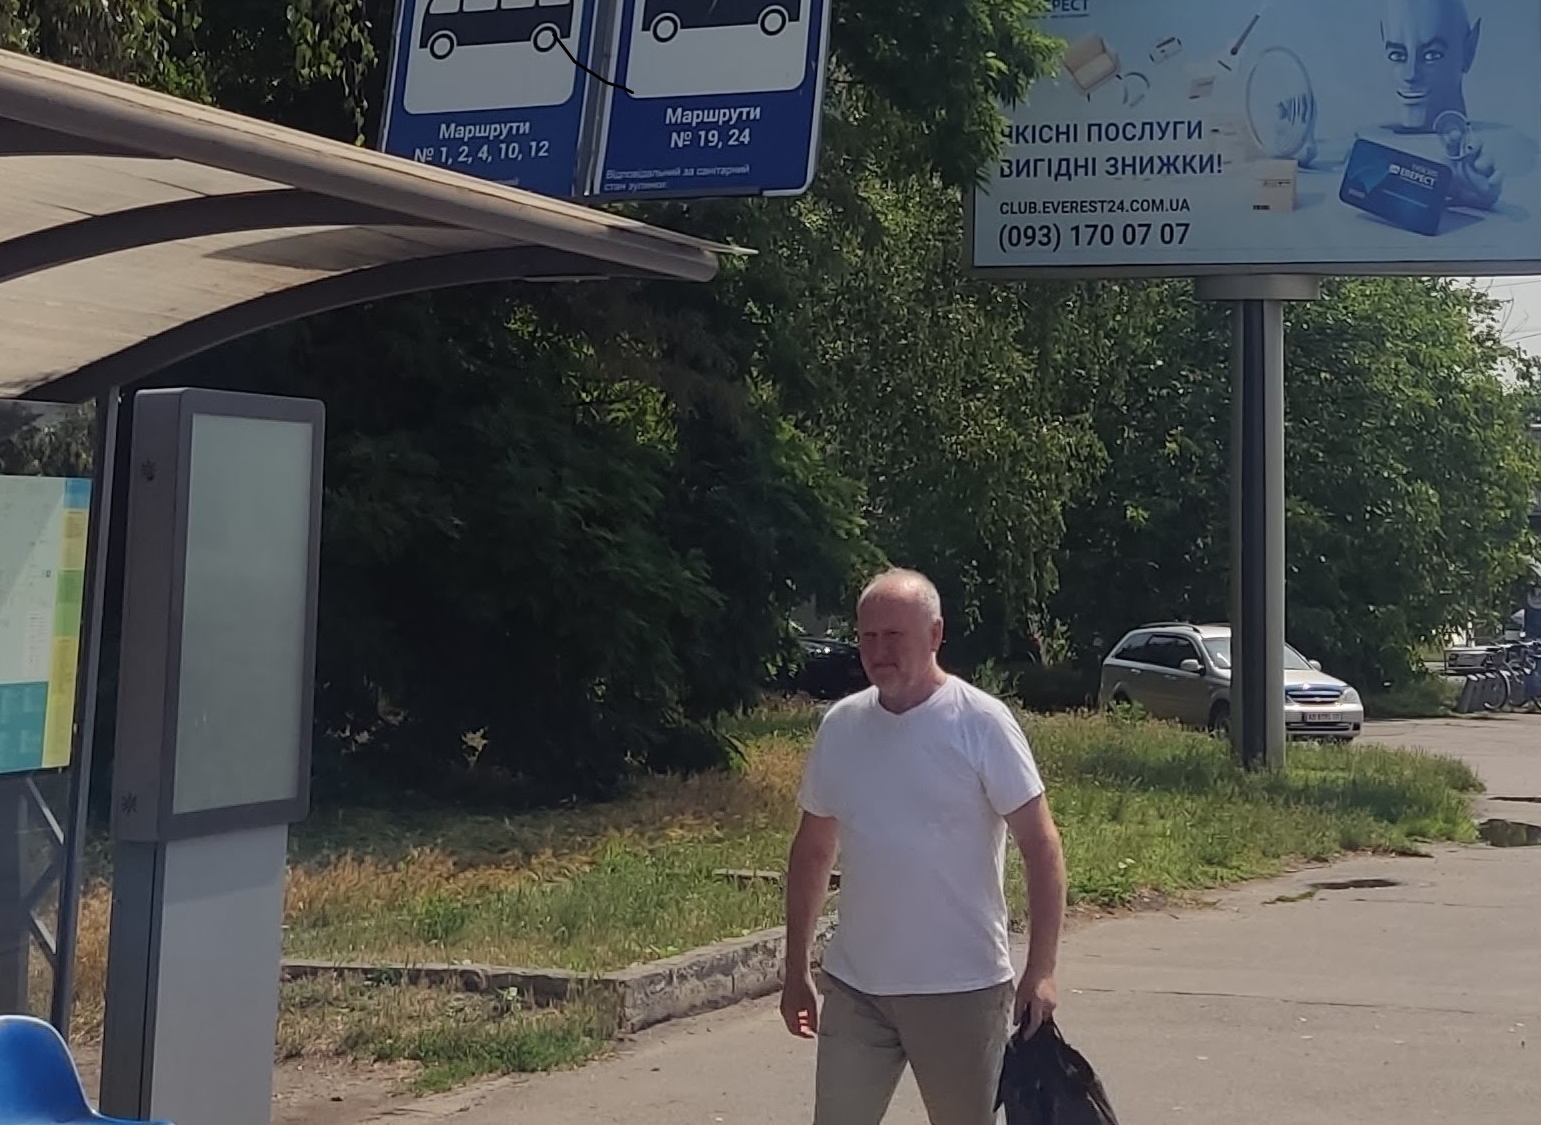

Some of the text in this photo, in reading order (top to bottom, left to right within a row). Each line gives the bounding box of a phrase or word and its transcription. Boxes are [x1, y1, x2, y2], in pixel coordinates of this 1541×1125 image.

[665, 106, 761, 127] Маршрути
[439, 121, 531, 142] Маршрути
[670, 128, 750, 149] № 19, 24
[1000, 124, 1078, 144] ЯКІСНІ
[1087, 120, 1203, 143] ПОСЛУГИ
[414, 141, 549, 165] № 1, 2, 4, 10, 12
[1000, 153, 1223, 181] ВИГІДНІ ЗНИЖКИ!
[1000, 198, 1191, 215] CLUB.EVEREST24.COM.UA
[999, 223, 1191, 253] (093) 170 07 07
